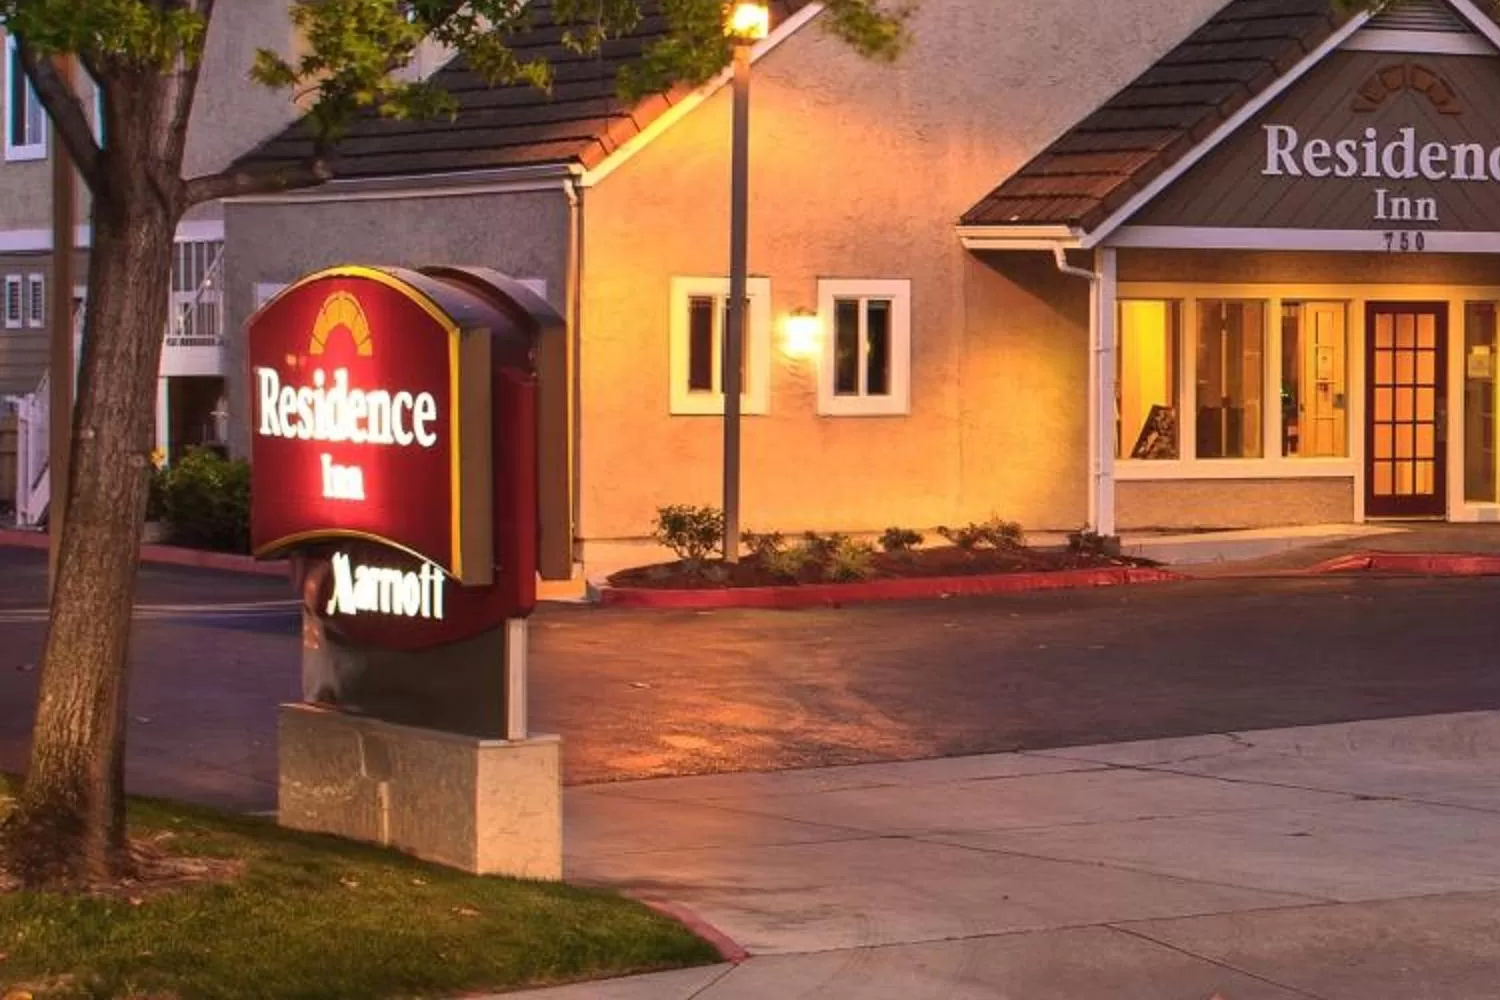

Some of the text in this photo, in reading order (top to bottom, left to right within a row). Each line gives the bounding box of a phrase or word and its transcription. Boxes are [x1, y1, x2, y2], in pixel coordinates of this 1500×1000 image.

[1373, 188, 1438, 221] Inn
[1384, 231, 1425, 251] 750
[257, 367, 438, 448] Residence
[320, 453, 365, 501] Inn
